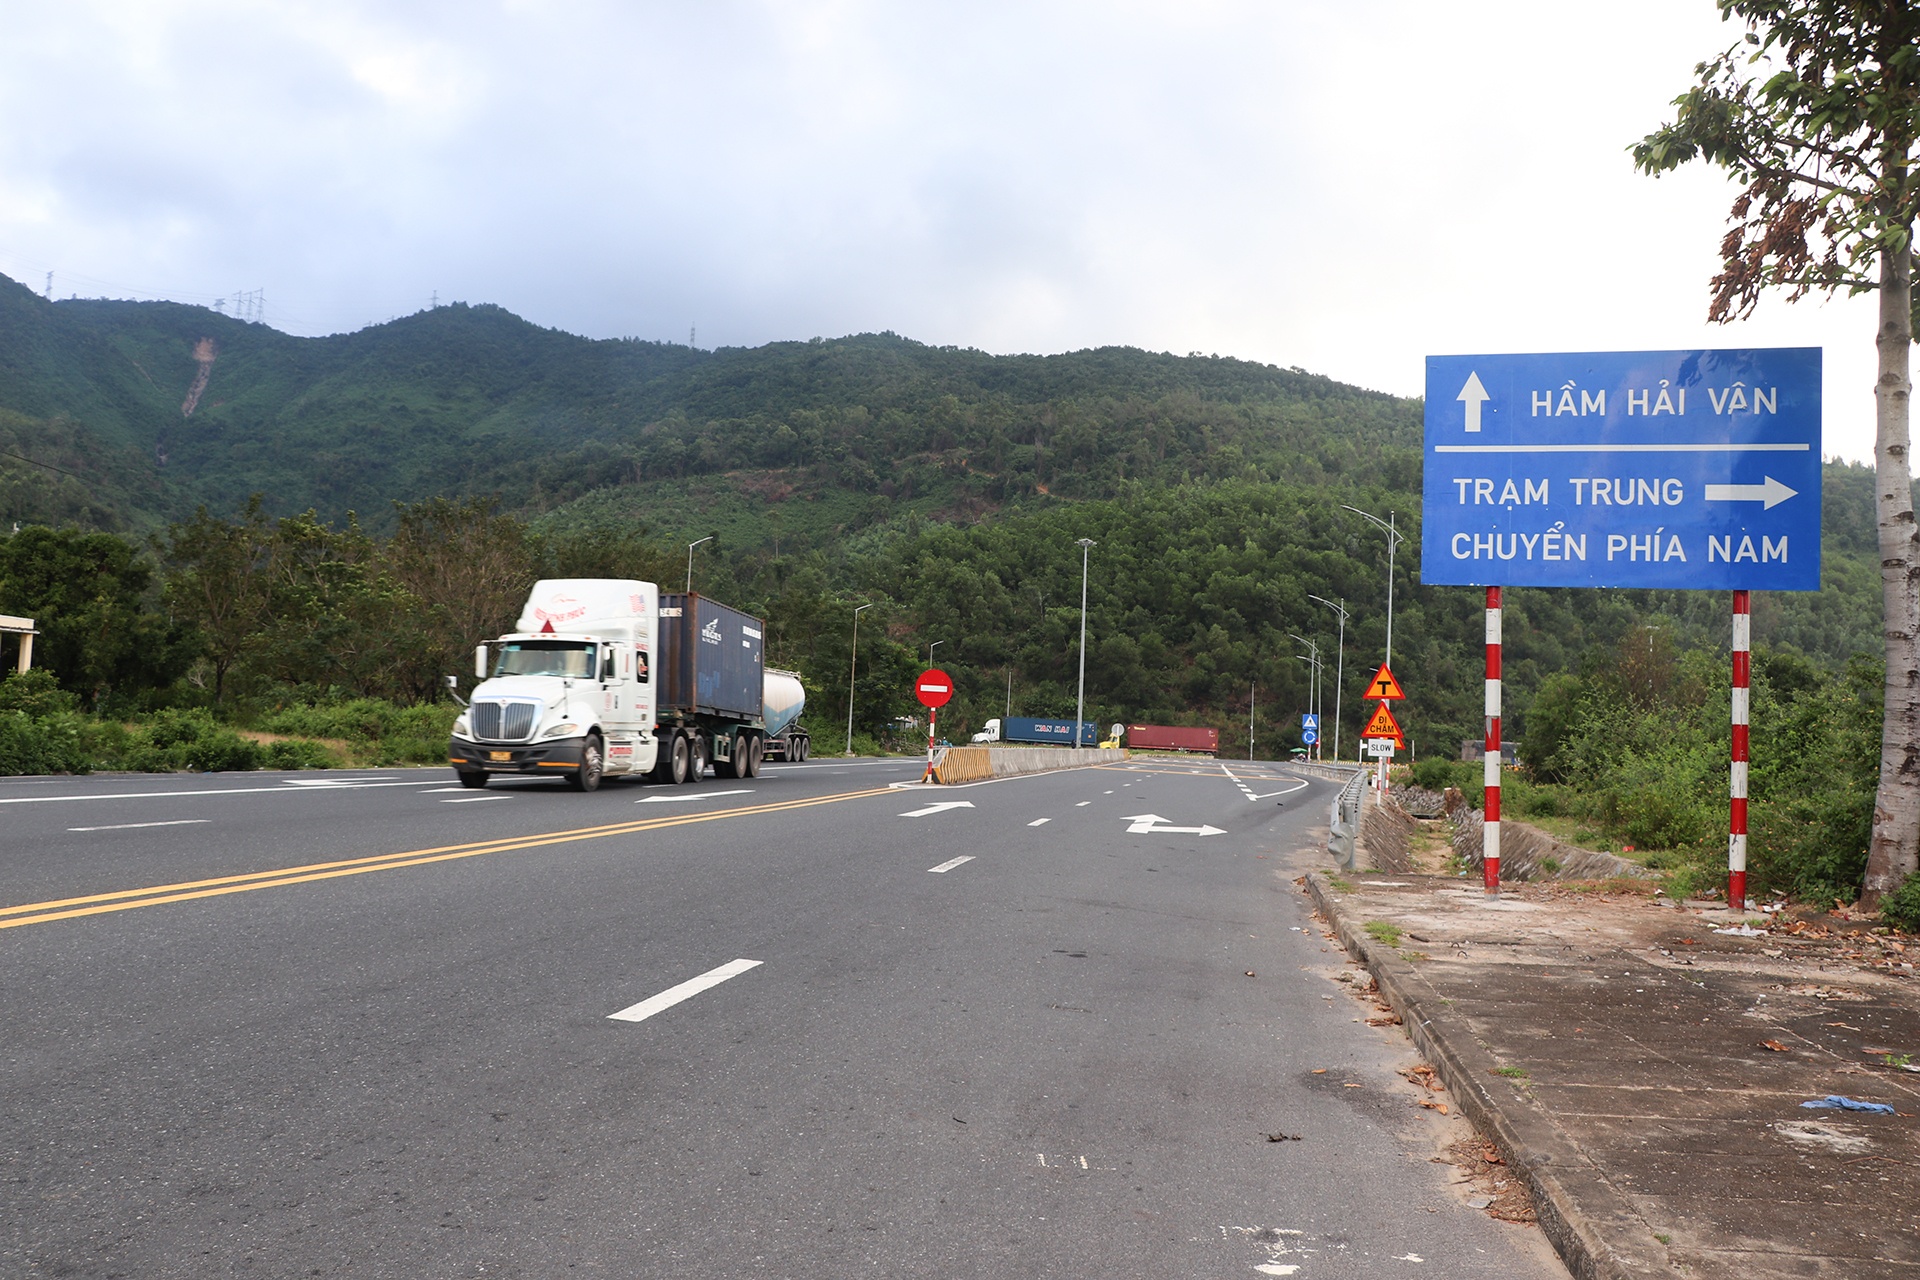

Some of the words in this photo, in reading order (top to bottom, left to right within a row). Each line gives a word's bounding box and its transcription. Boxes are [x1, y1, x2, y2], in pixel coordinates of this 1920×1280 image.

[1531, 379, 1606, 417] HẦM
[1627, 379, 1686, 416] HẢI
[1707, 381, 1777, 415] VÂN
[1453, 478, 1549, 511] TRẠM
[1569, 478, 1684, 506] TRUNG
[1451, 521, 1587, 561] CHUYỂN
[1607, 527, 1687, 562] PHÍA
[1708, 534, 1788, 563] NAM
[1034, 724, 1053, 733] WAN
[1378, 715, 1387, 724] ĐI
[1371, 743, 1392, 752] SLOW
